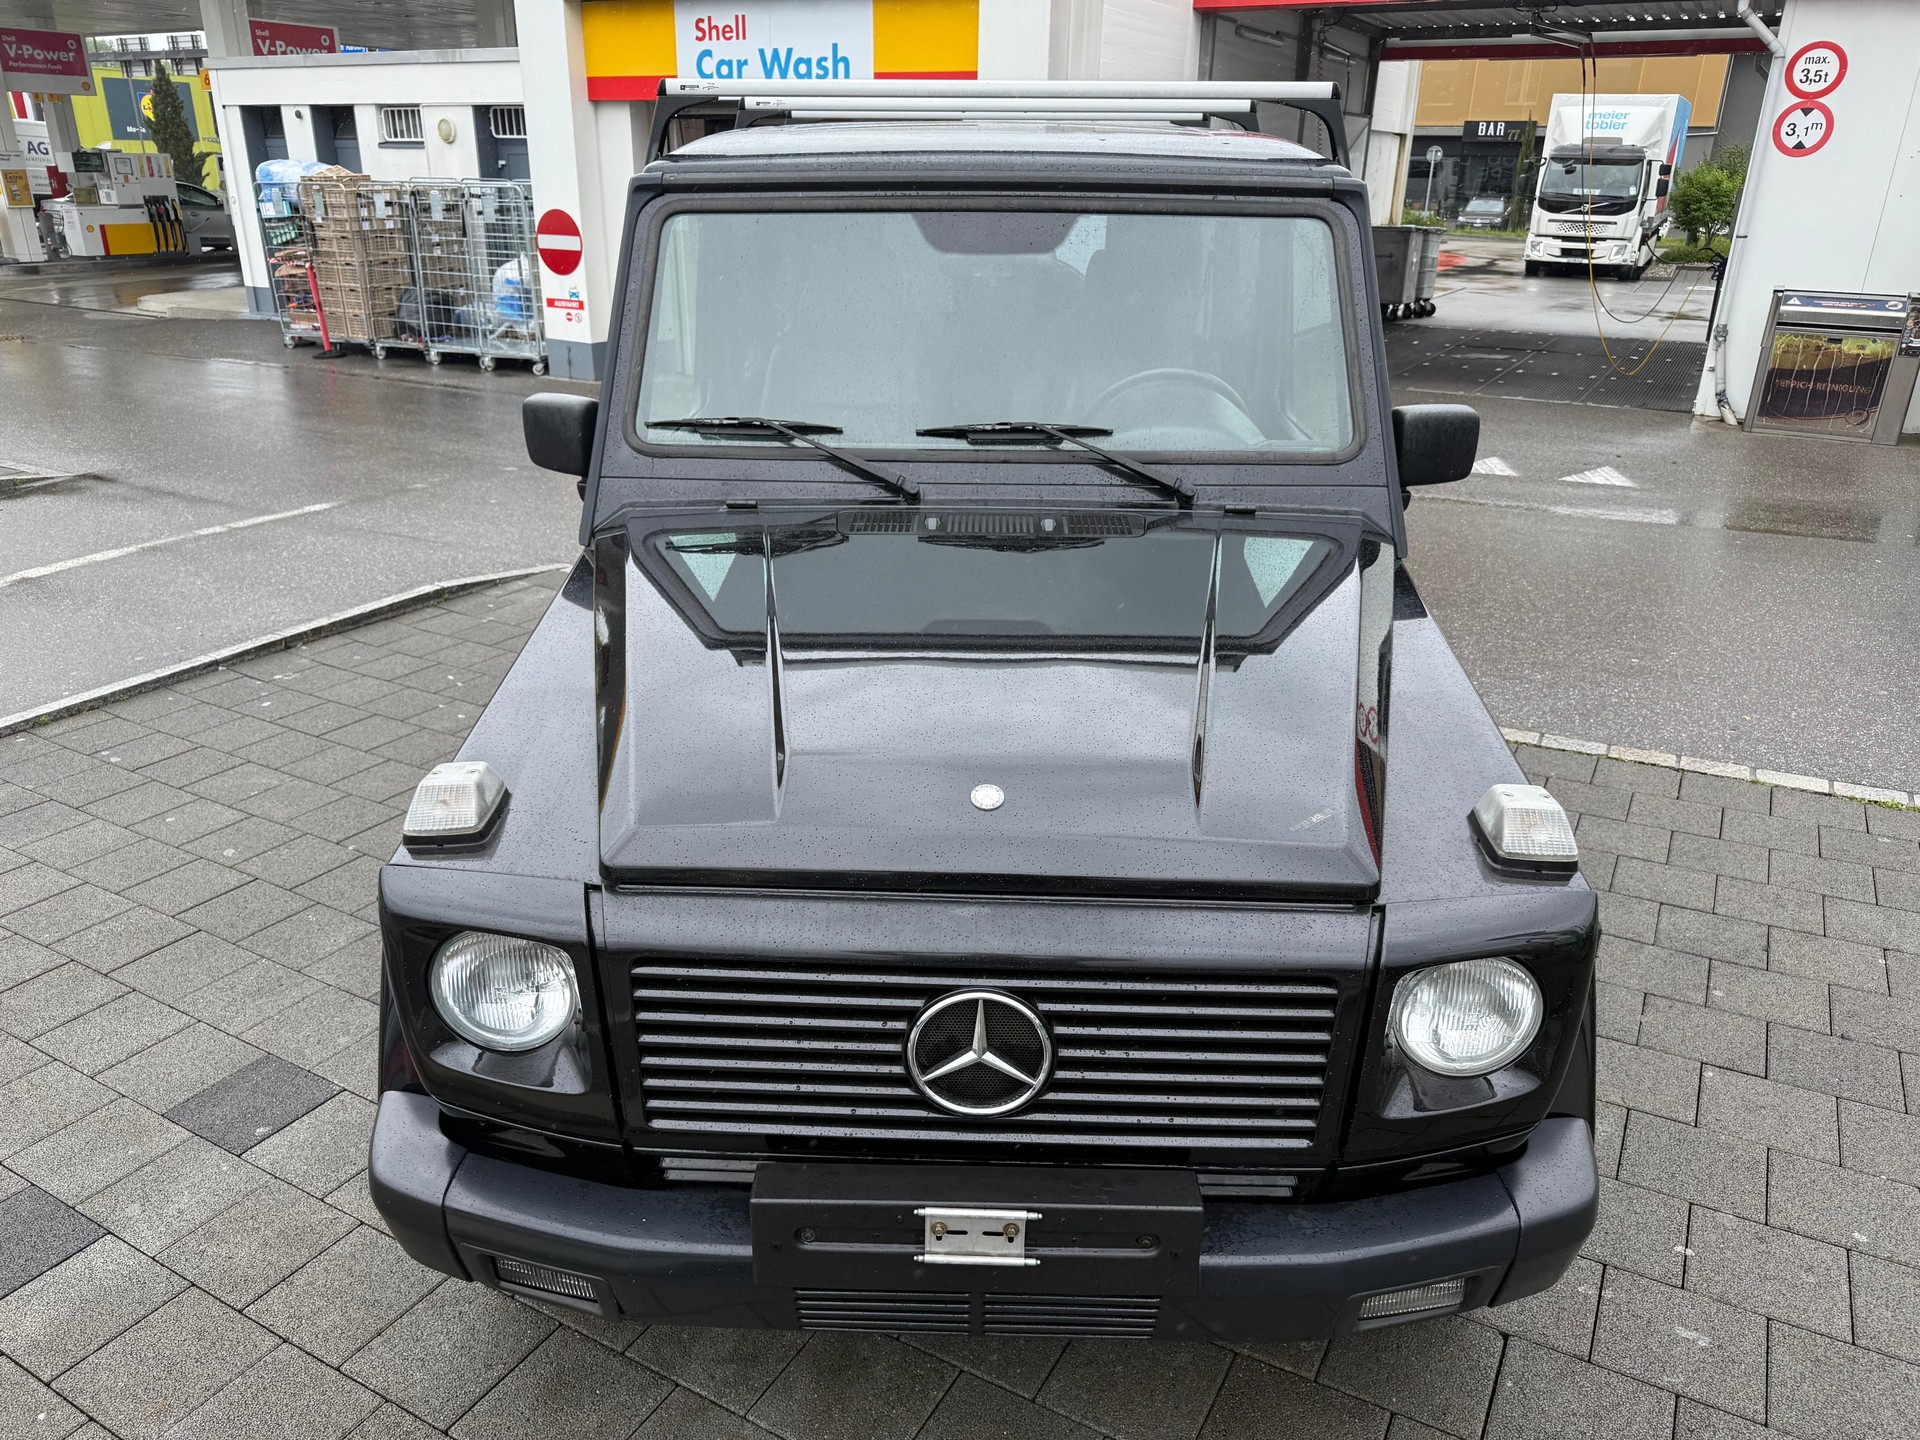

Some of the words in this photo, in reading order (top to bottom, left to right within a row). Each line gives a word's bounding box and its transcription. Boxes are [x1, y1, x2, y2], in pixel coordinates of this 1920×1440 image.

[695, 14, 747, 42] Shell
[3, 43, 75, 61] V-Power
[696, 48, 748, 79] Car
[757, 42, 850, 79] Wash
[1804, 55, 1831, 65] max.
[1588, 110, 1631, 120] meier
[1477, 121, 1506, 136] BAR
[1585, 119, 1629, 130] tobler
